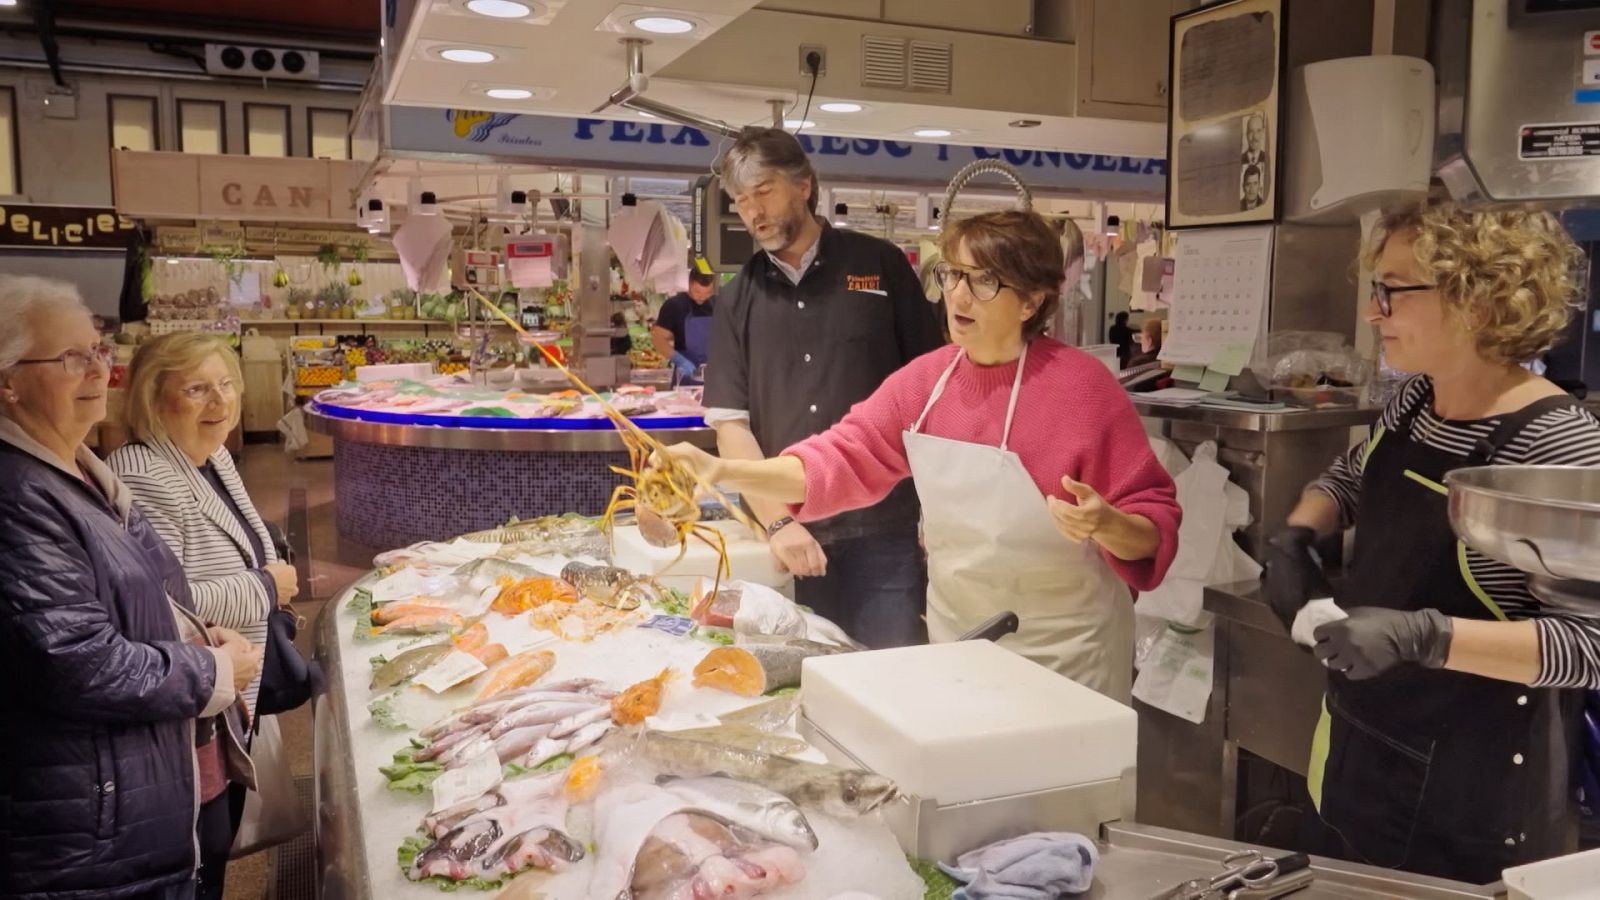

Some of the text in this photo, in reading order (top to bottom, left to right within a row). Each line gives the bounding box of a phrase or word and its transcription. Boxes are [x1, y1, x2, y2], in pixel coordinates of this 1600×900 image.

[574, 117, 711, 147] PEIX
[797, 134, 912, 158] ESC
[221, 182, 314, 209] CAN
